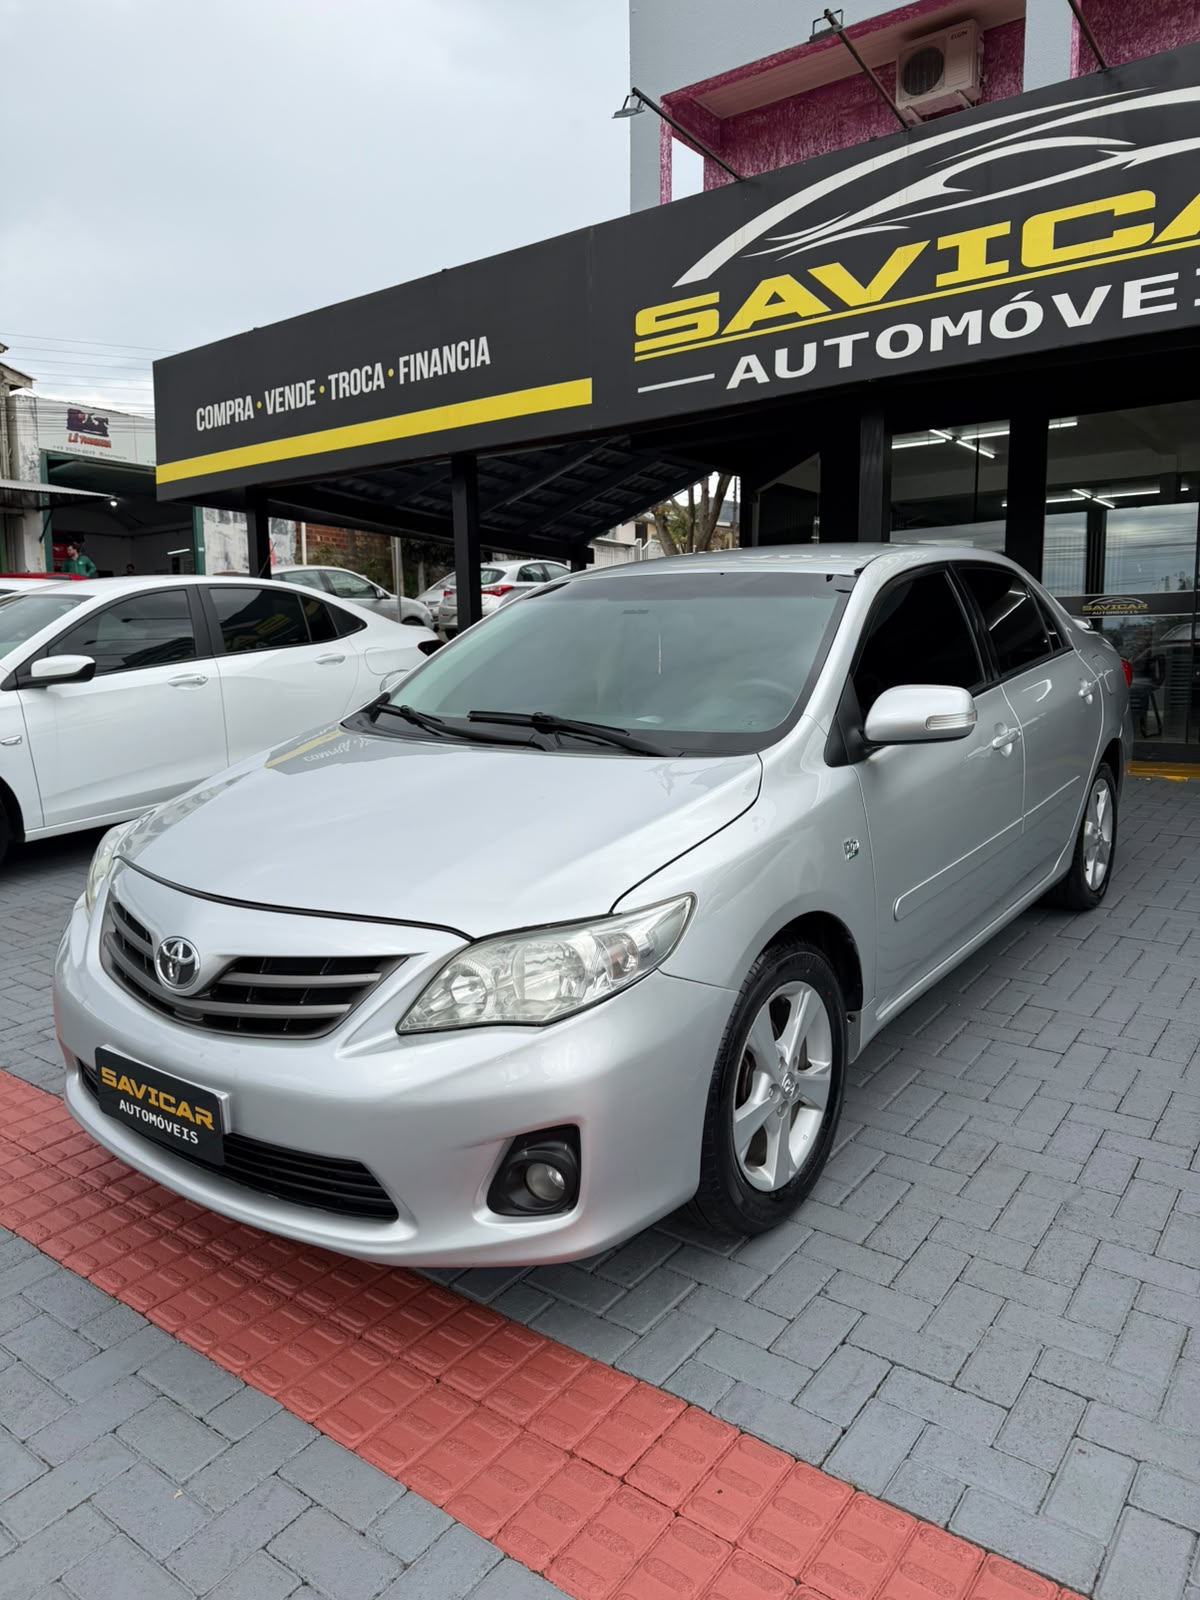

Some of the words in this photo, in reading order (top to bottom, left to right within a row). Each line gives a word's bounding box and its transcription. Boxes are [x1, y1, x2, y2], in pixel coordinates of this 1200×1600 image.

[726, 268, 1200, 390] AUTOMÓVE
[196, 395, 254, 431] COMPRA
[264, 379, 317, 415] VENDE
[328, 362, 385, 401] TROCA
[399, 336, 491, 385] FINANCIA
[1082, 603, 1148, 612] SAVICAR
[101, 1066, 215, 1130] SAVICAR
[119, 1099, 199, 1145] AUTOMÓVEIS
